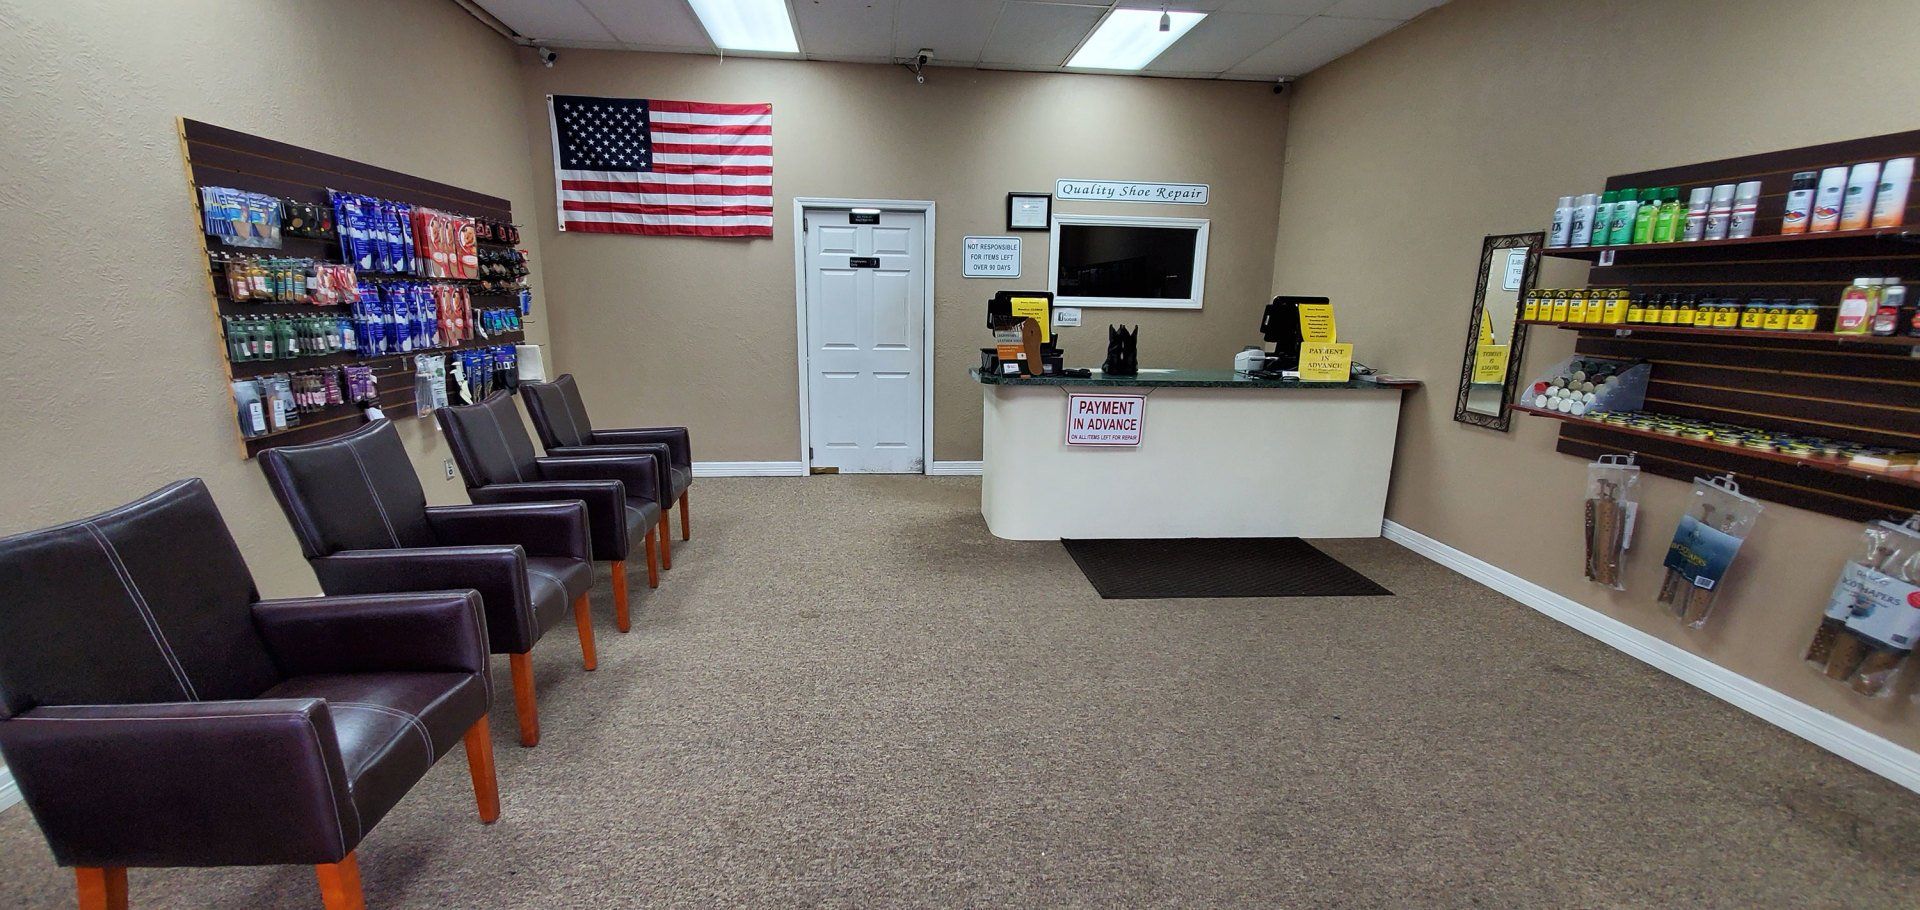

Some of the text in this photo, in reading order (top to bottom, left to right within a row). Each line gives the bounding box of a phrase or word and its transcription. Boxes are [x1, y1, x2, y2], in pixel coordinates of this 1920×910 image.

[1063, 184, 1202, 200] Quality Shoe Repair
[1079, 401, 1135, 415] PAYMENT
[1074, 418, 1137, 431] IN ADVANCE
